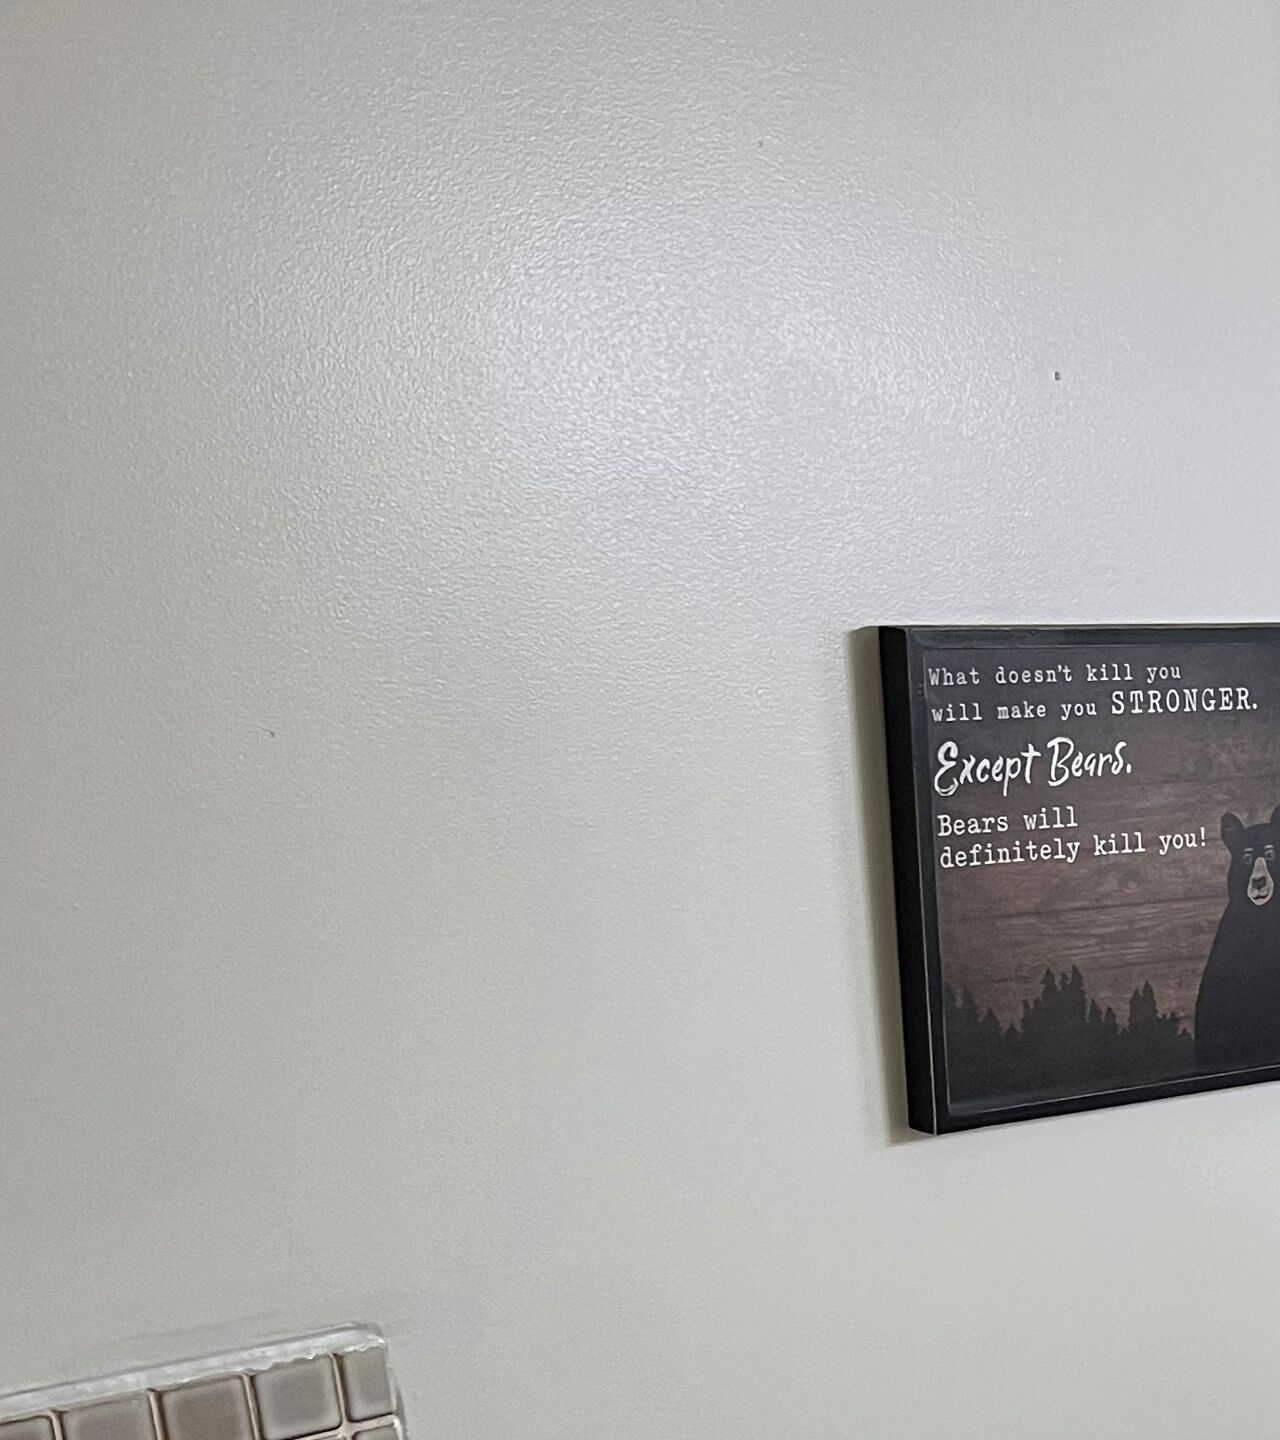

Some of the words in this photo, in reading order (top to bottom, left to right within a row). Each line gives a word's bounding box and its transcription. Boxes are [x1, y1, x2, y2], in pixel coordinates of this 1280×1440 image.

[928, 667, 980, 686] What
[995, 664, 1072, 684] doesn't
[1086, 663, 1133, 682] kill
[1147, 665, 1181, 684] you
[931, 702, 983, 722] will
[997, 701, 1047, 720] make
[1061, 702, 1097, 721] you
[1111, 687, 1258, 715] STRONGER.
[934, 741, 1041, 797] Except
[1046, 736, 1132, 787] Bears.
[937, 814, 1009, 837] Bears
[1023, 806, 1078, 831] will
[939, 837, 1081, 869] definitely
[1093, 831, 1146, 857] kill
[1159, 827, 1206, 856] you!
